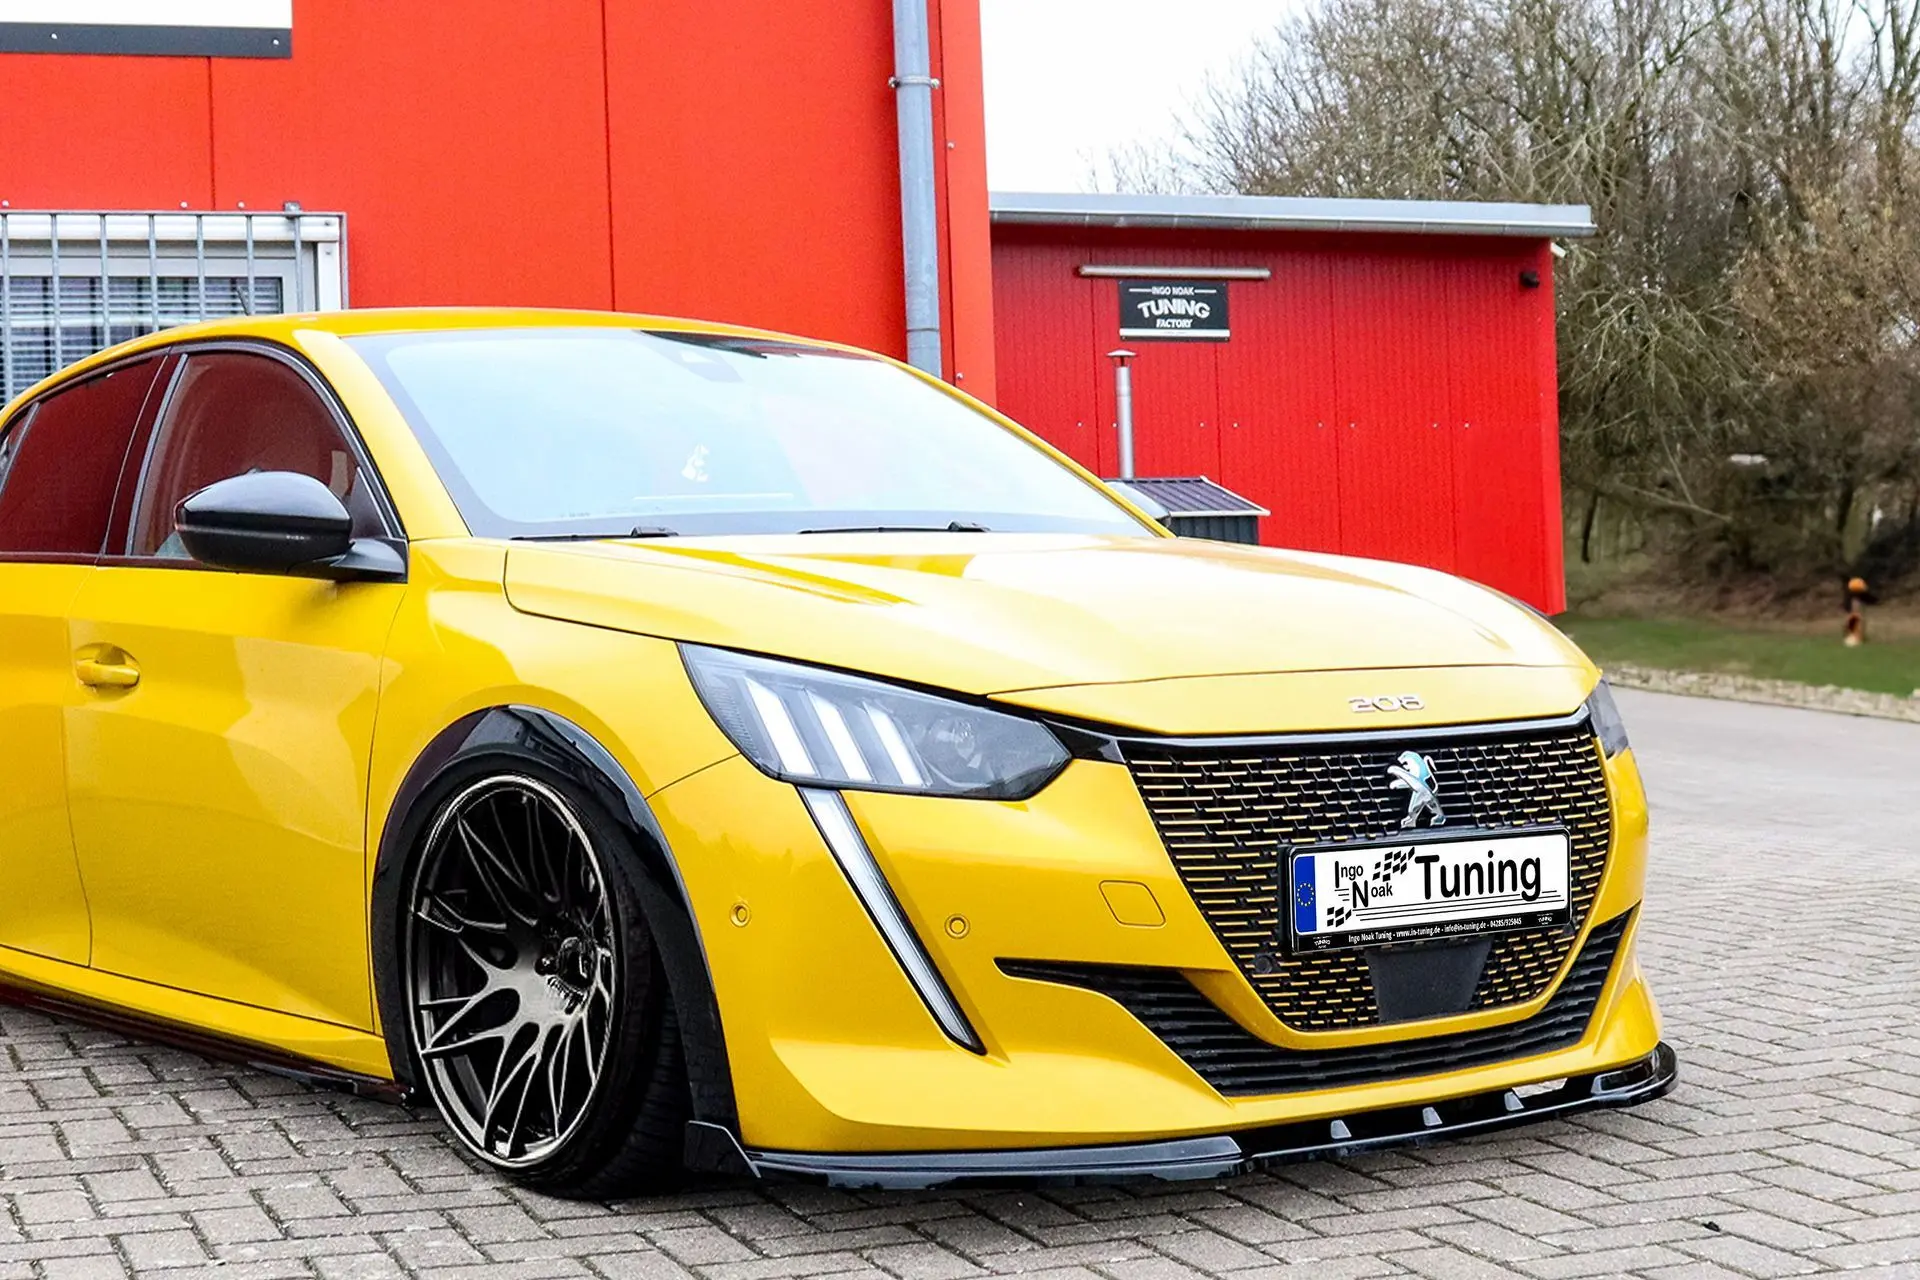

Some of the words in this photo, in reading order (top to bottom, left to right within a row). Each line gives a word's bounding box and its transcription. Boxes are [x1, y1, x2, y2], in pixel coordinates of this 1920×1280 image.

[1151, 286, 1171, 295] INGO
[1172, 286, 1194, 295] NOAK
[1137, 298, 1210, 318] TUNING
[1156, 318, 1193, 328] FACTORY
[1348, 695, 1425, 713] 208
[1334, 860, 1364, 889] Ingo
[1414, 850, 1541, 902] Tuning
[1352, 880, 1393, 909] Noak
[1348, 934, 1360, 944] Ingo
[1361, 931, 1375, 942] Noak
[1375, 930, 1392, 941] Tuning
